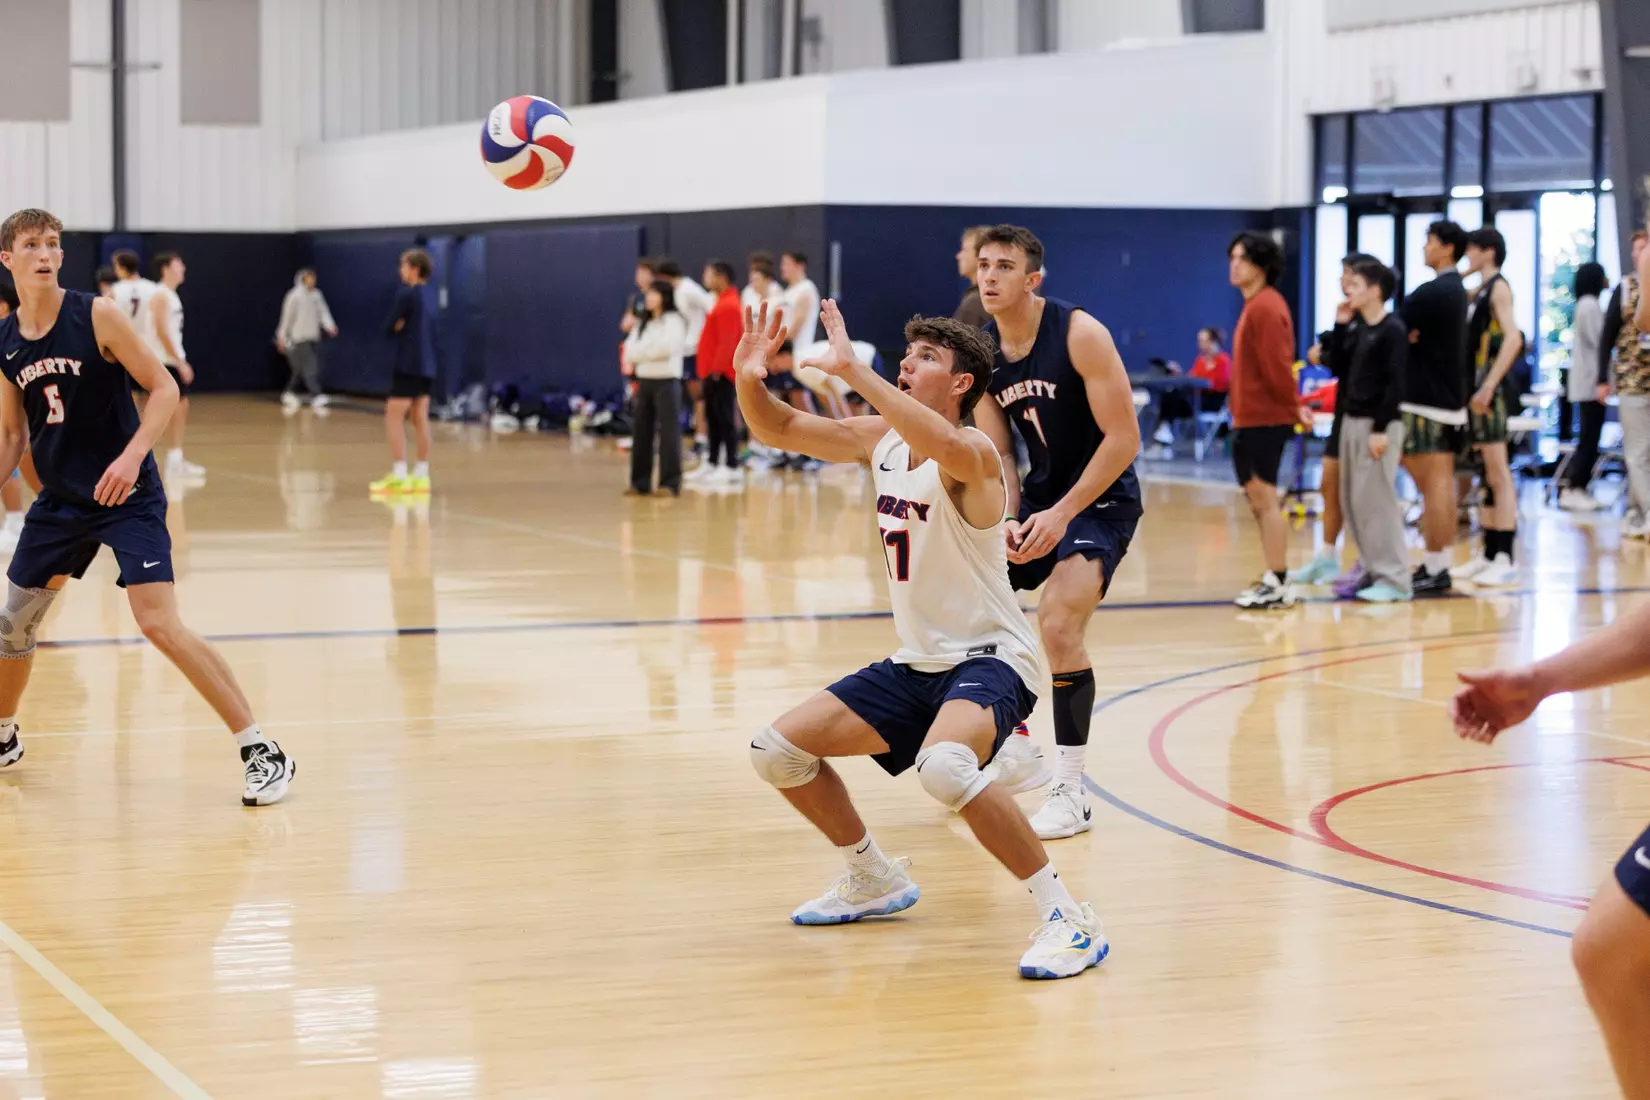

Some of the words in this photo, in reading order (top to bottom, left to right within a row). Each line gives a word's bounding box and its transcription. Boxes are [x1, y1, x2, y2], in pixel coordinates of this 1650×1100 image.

[15, 356, 83, 391] LIBERTY
[42, 383, 65, 425] 5
[994, 379, 1057, 409] LIBERTY
